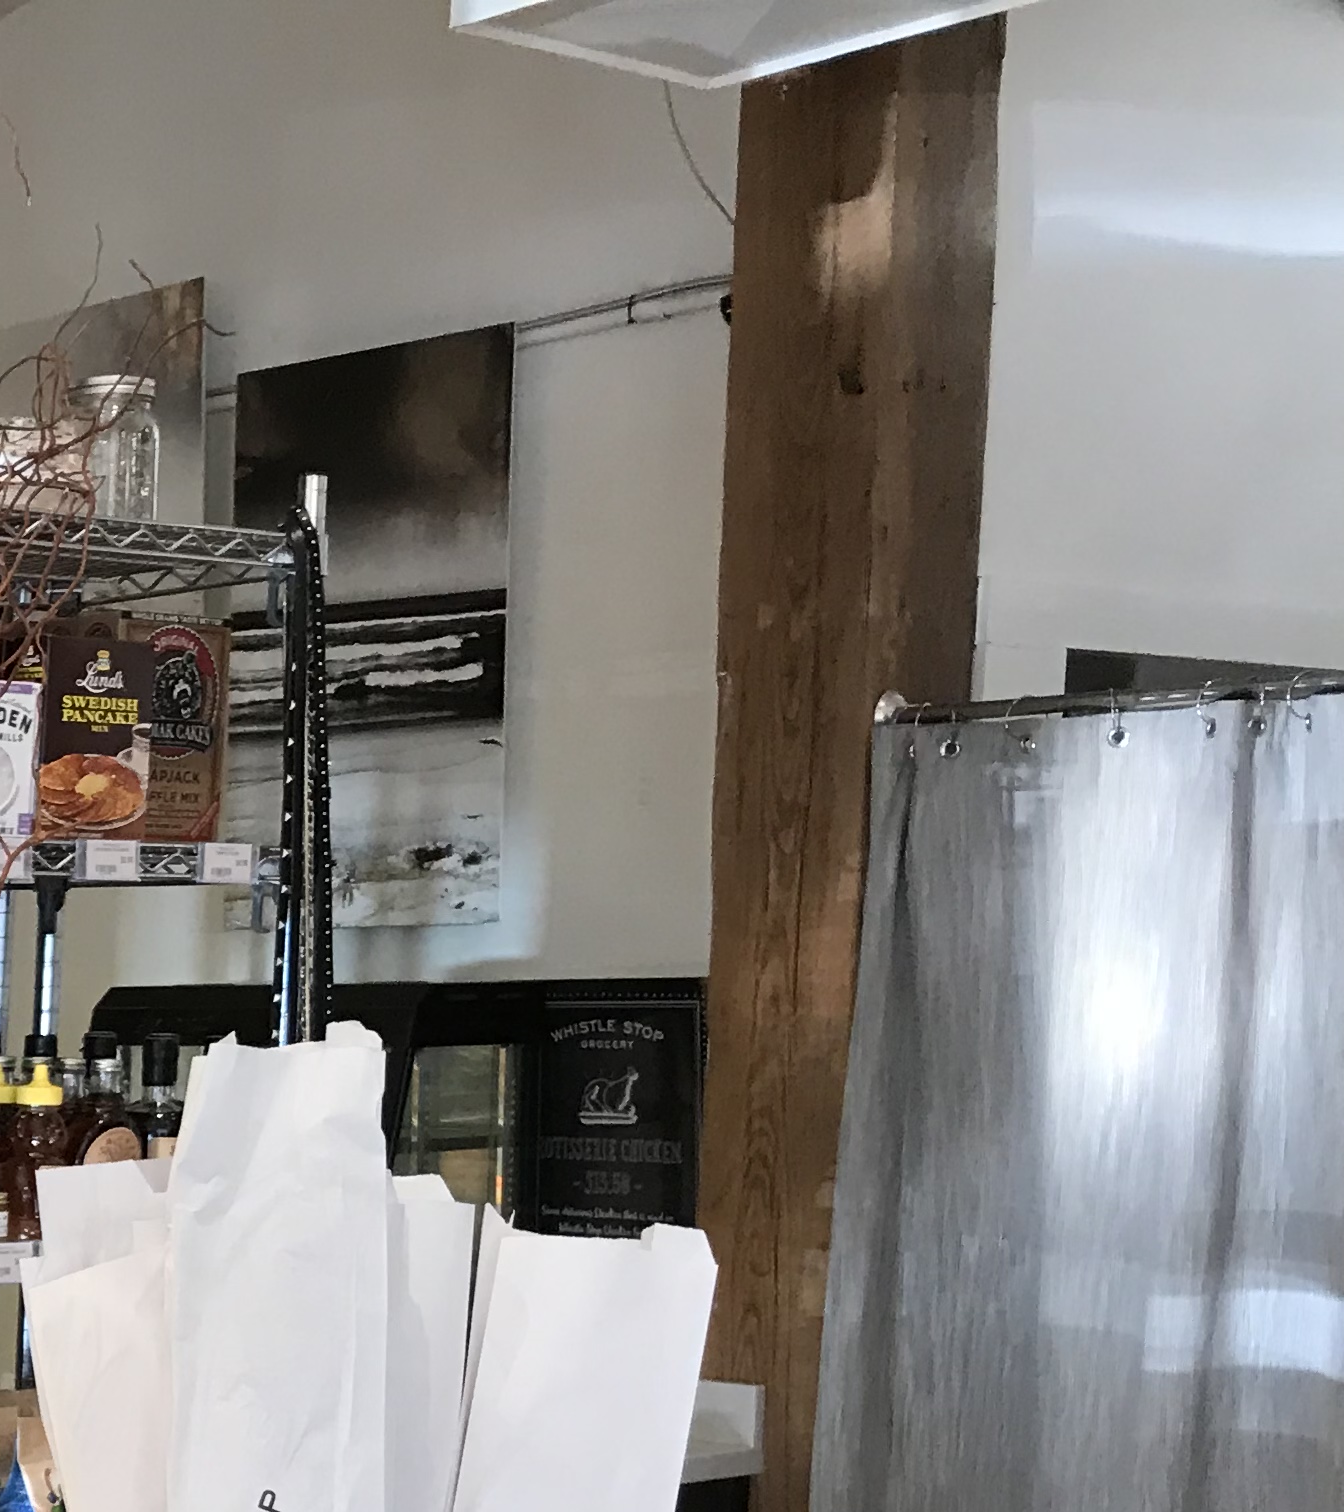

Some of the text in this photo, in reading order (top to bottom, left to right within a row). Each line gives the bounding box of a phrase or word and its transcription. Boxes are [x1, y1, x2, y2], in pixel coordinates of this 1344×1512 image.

[62, 695, 139, 712] SWEDISH
[61, 709, 139, 725] PANCAKE
[91, 725, 109, 733] MIX
[149, 768, 201, 785] APJACK
[550, 1018, 665, 1042] WHISTLE STOP
[580, 1039, 635, 1050] GROCERY
